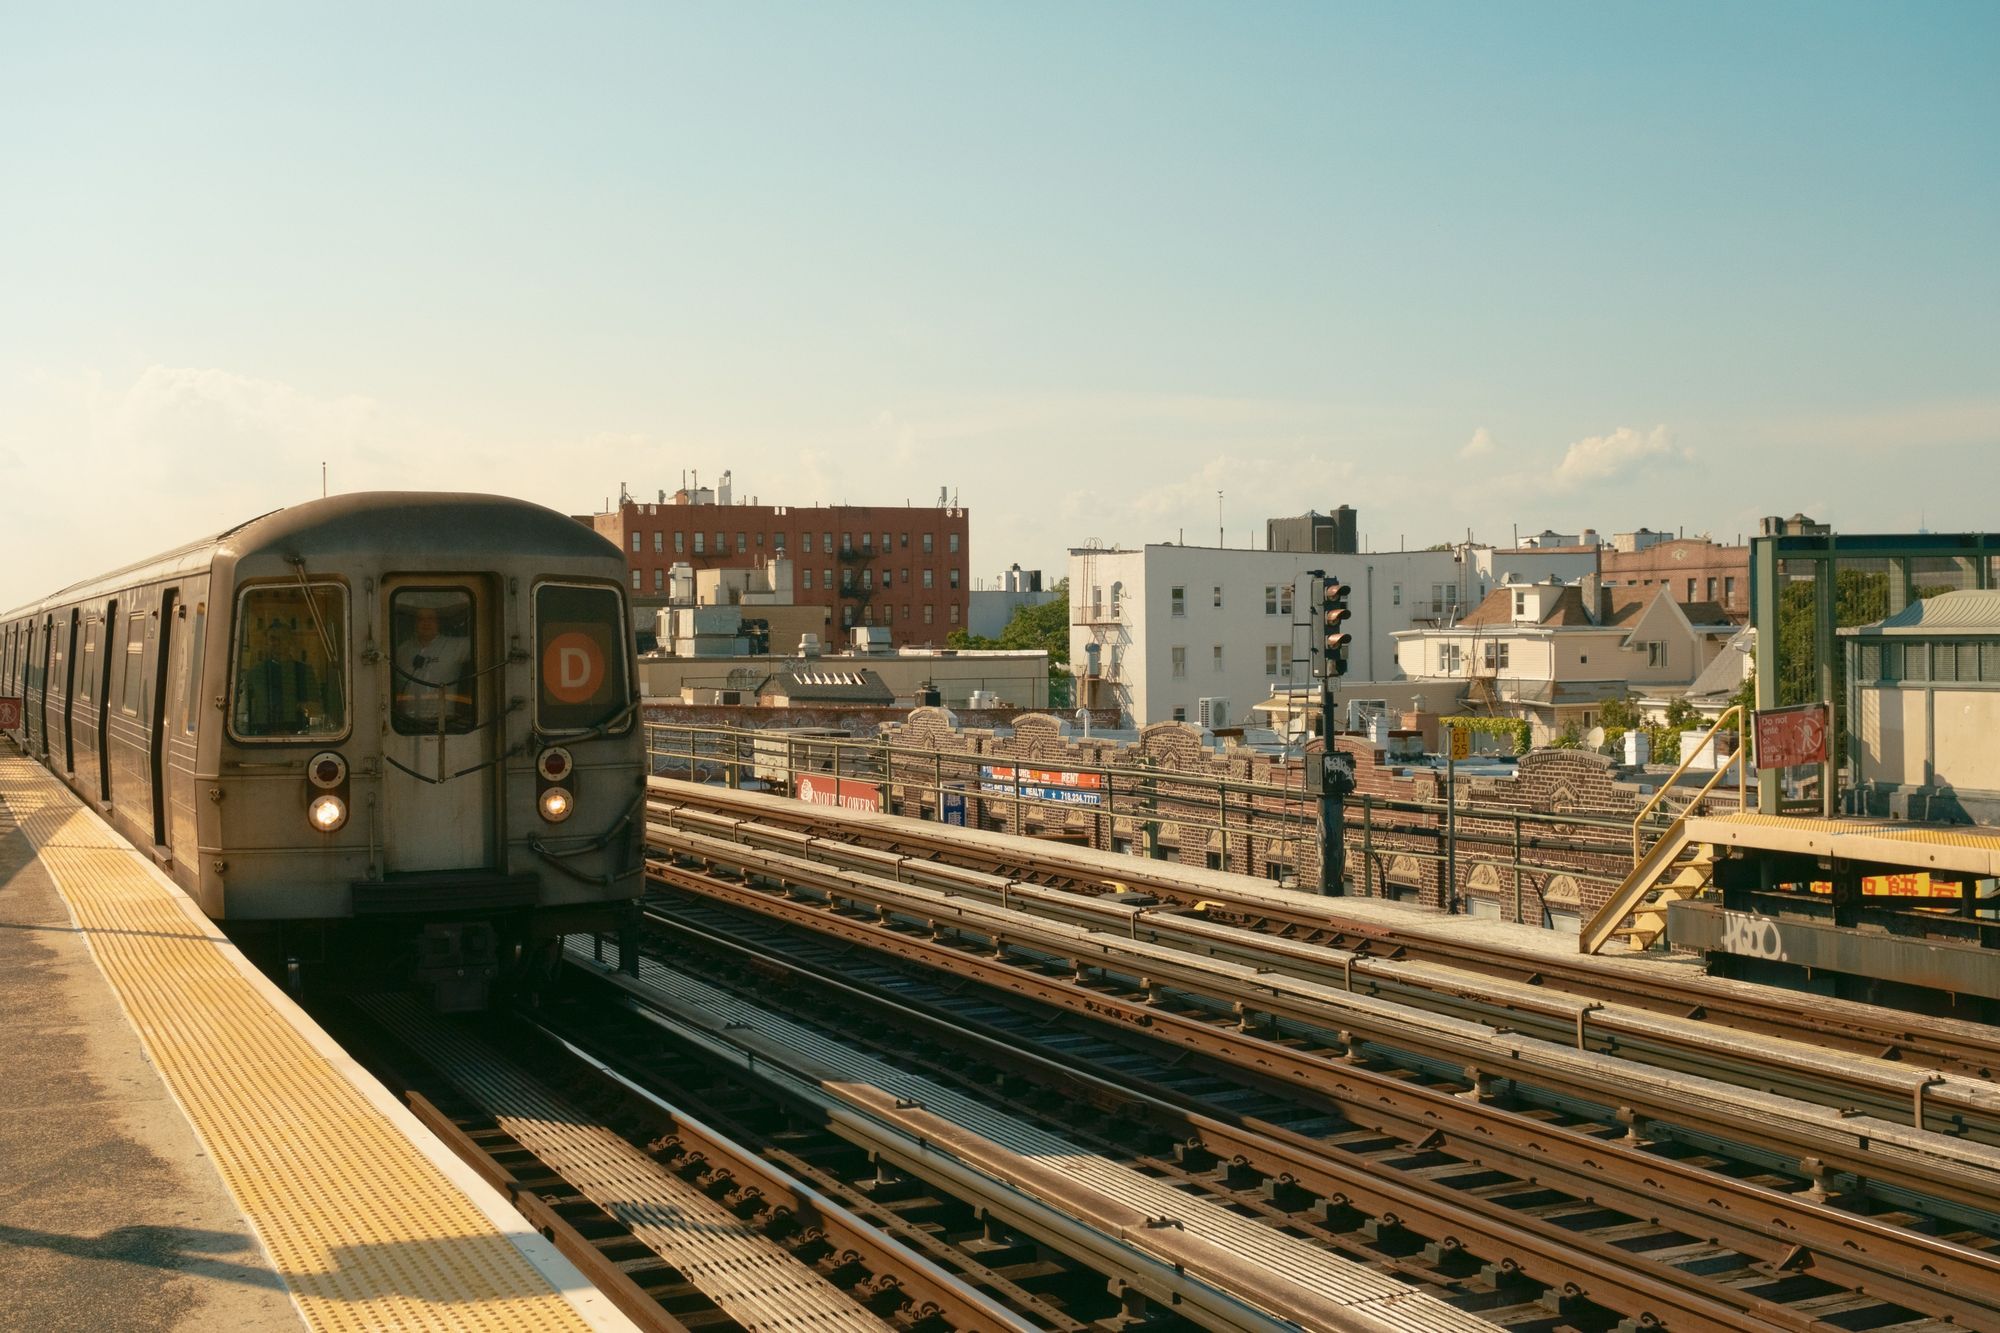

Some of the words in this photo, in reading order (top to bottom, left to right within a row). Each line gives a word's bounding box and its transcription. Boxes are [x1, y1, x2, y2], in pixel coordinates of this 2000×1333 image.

[560, 648, 591, 689] D
[1775, 716, 1787, 724] not
[1454, 733, 1467, 743] GT
[1454, 744, 1467, 756] 25
[1012, 768, 1030, 778] SORE
[1061, 772, 1079, 784] RENT
[1025, 786, 1045, 798] REALTY
